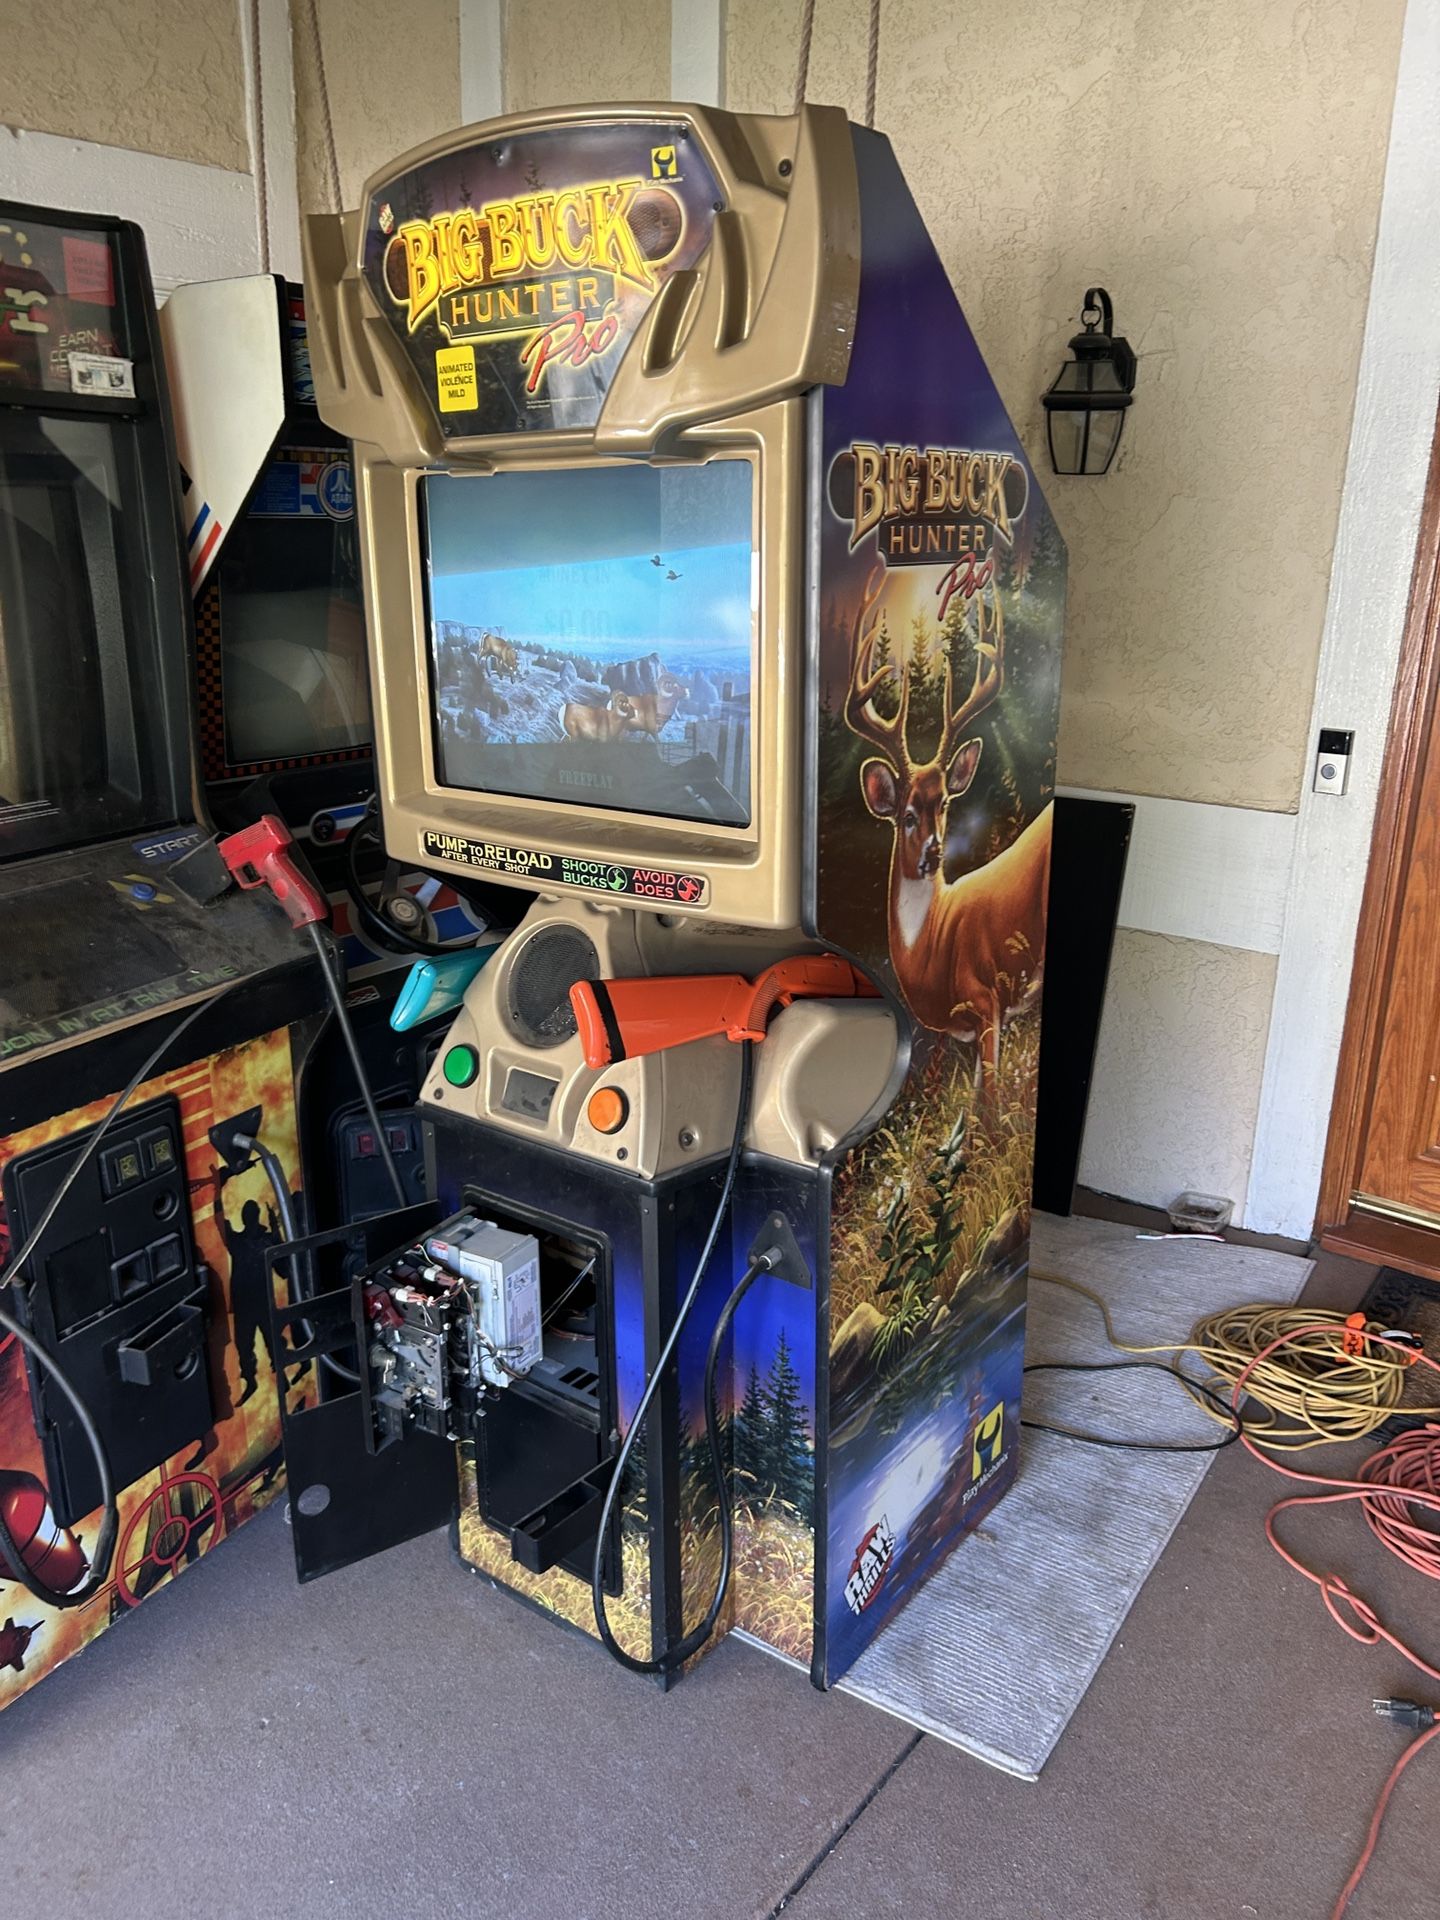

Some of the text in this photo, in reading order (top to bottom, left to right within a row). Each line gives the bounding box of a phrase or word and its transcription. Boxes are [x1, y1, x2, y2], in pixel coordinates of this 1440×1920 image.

[400, 181, 655, 326] BIG BUCK
[451, 276, 601, 327] HUNTER
[59, 328, 98, 347] EARN
[521, 310, 619, 393] Pro
[439, 362, 474, 374] ANIMATED
[440, 375, 474, 387] VIOLENCE
[447, 388, 466, 399] MILD
[850, 444, 1013, 552] BIG BUCK
[889, 525, 986, 554] HUNTER
[936, 552, 993, 622] Pro
[140, 833, 200, 858] START
[427, 832, 552, 870] PUMP TO RELOAD
[441, 850, 530, 875] AFTER EVERY SHOT
[561, 859, 607, 876] SHOOT
[563, 872, 607, 889] BUCKS
[632, 870, 676, 885] AVOID
[635, 883, 674, 898] DOES
[0, 965, 239, 1056] JOIN IN AT ANY TIME
[843, 1514, 891, 1610] RAW
[852, 1533, 897, 1616] THRILLS
